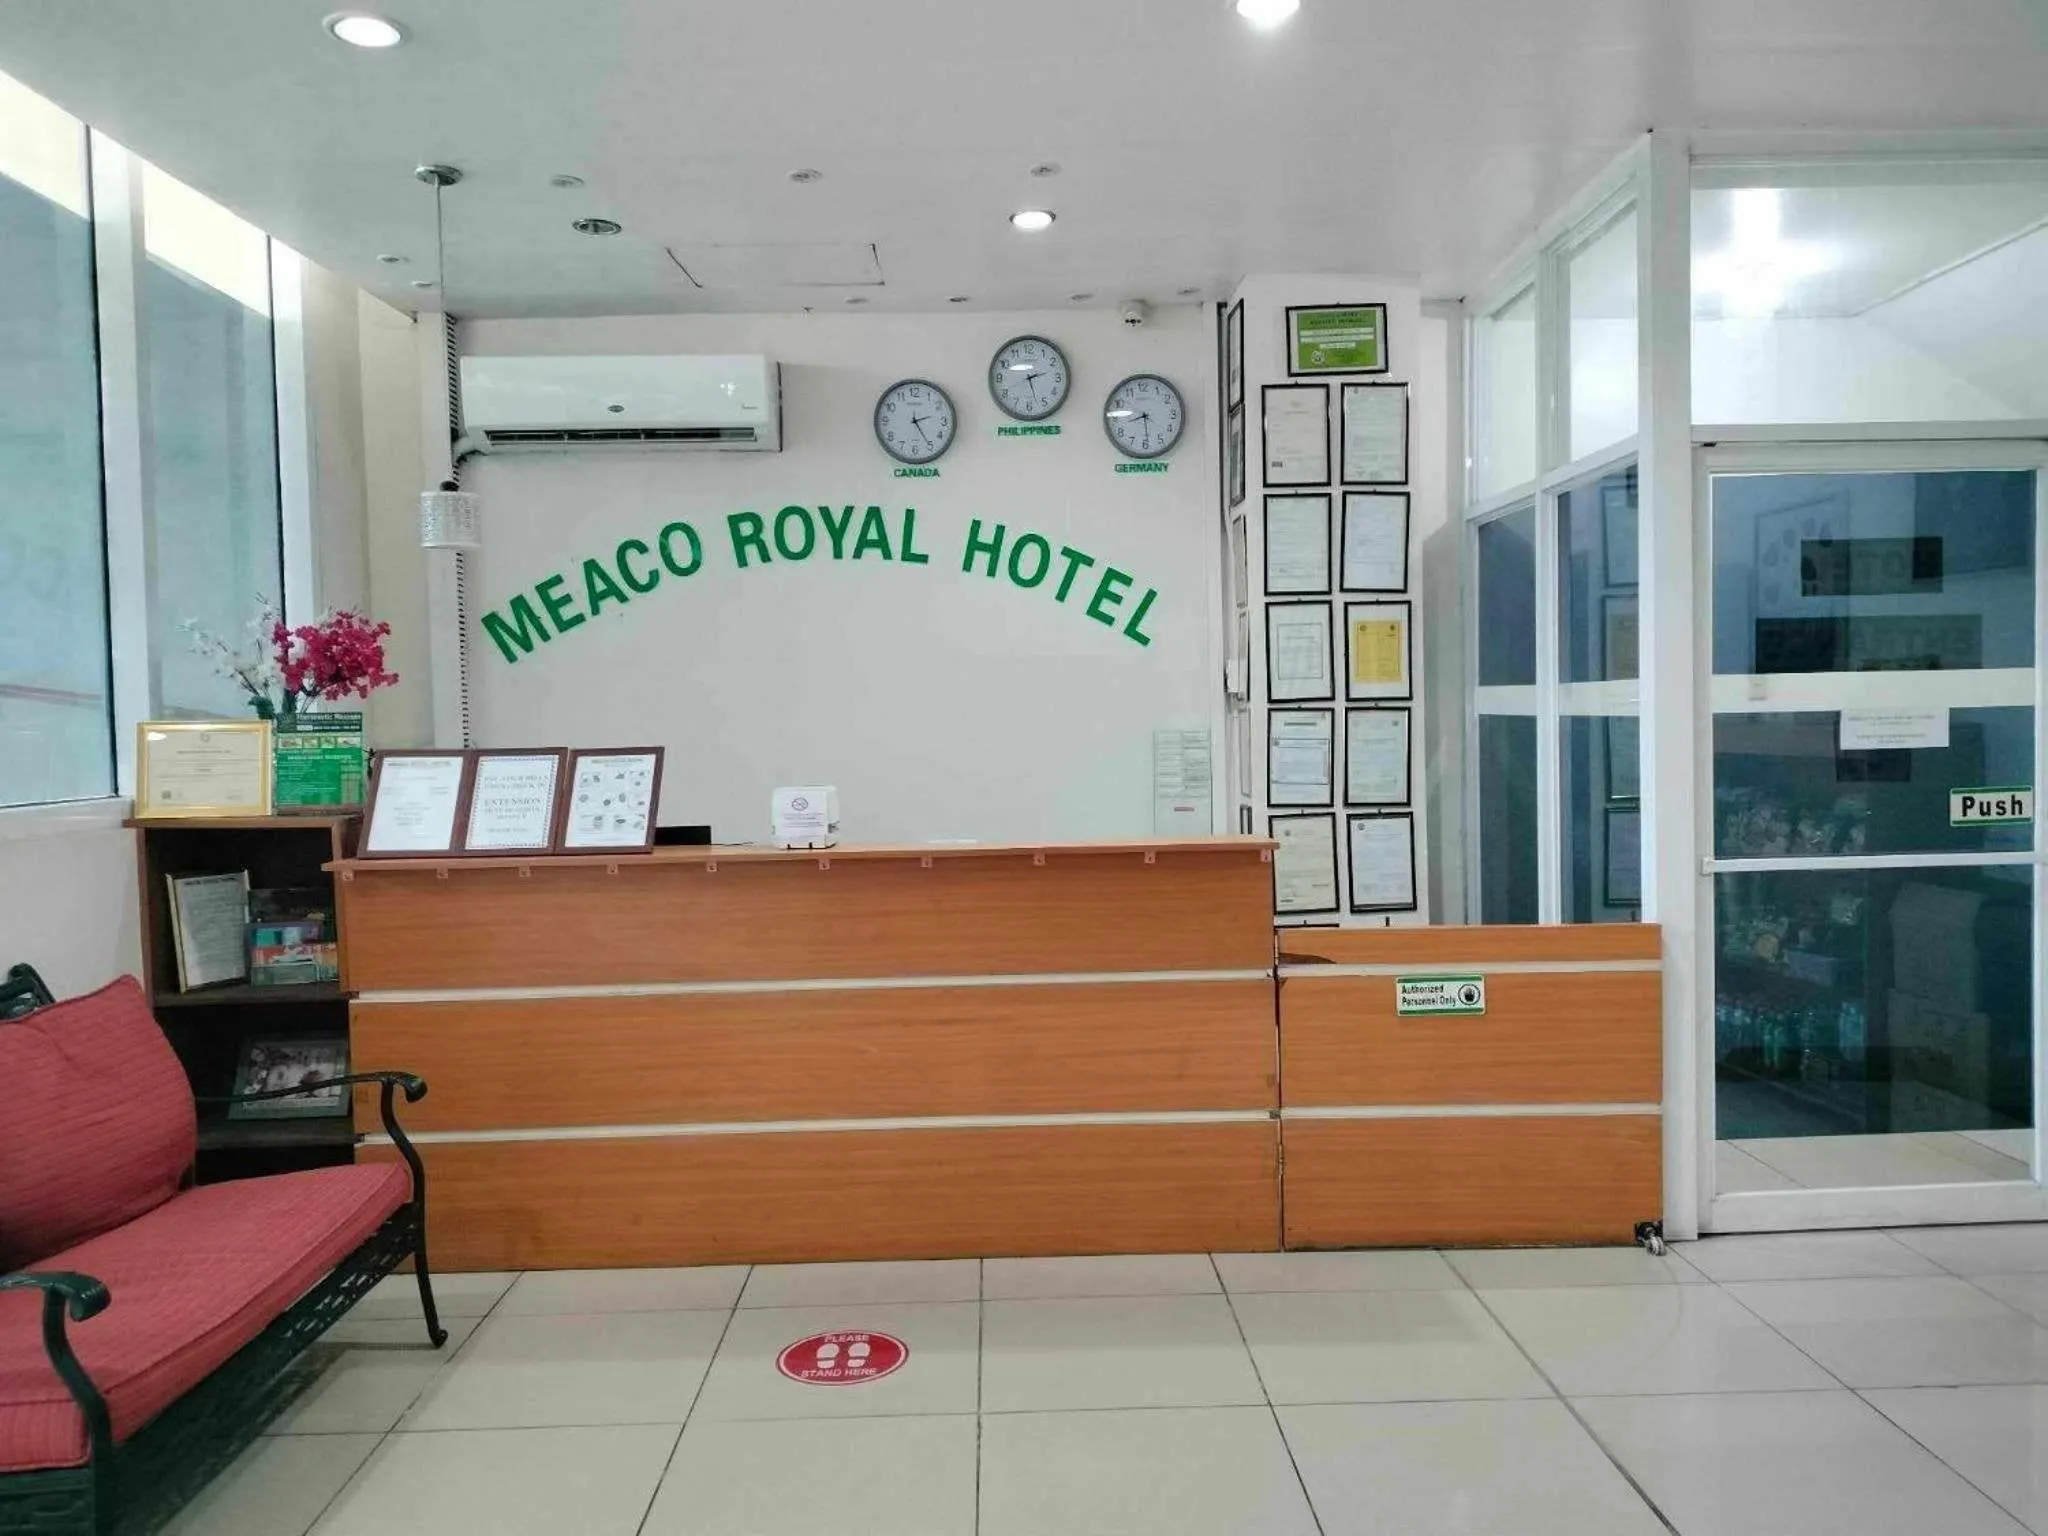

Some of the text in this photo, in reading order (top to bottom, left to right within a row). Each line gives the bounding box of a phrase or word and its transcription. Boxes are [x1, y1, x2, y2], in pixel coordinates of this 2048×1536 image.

[1012, 349, 1019, 358] 11
[1024, 344, 1034, 354] 12
[1050, 357, 1056, 366] 2
[997, 374, 1002, 383] 9
[1055, 373, 1061, 382] 3
[1138, 383, 1148, 392] 12
[898, 392, 904, 401] 11
[910, 388, 919, 397] 12
[1126, 388, 1134, 397] 11
[1042, 397, 1047, 407] 5
[1165, 394, 1170, 404] 2
[887, 403, 896, 412] 10
[935, 401, 942, 410] 2
[1027, 402, 1032, 411] 6
[1170, 410, 1176, 419] 3
[941, 417, 947, 426] 3
[998, 426, 1061, 436] PHILIPPINES
[1118, 428, 1124, 437] 8
[1167, 424, 1172, 432] 4
[888, 432, 893, 441] 8
[937, 431, 942, 440] 4
[1158, 434, 1163, 444] 5
[899, 441, 905, 450] 7
[928, 441, 933, 450] 5
[1129, 437, 1135, 446] 7
[1143, 440, 1148, 449] 6
[912, 446, 918, 454] 6
[894, 468, 940, 477] CANADA
[1115, 463, 1169, 473] GERMANY
[482, 523, 703, 665] MEACO
[728, 507, 930, 569] ROYAL
[963, 520, 1158, 647] HOTEL
[1962, 794, 2023, 817] Push
[1402, 984, 1444, 994] Authorized
[1402, 996, 1456, 1007] Personnel Only
[824, 1335, 870, 1343] PLEASE
[801, 1367, 877, 1378] STAND HERE
